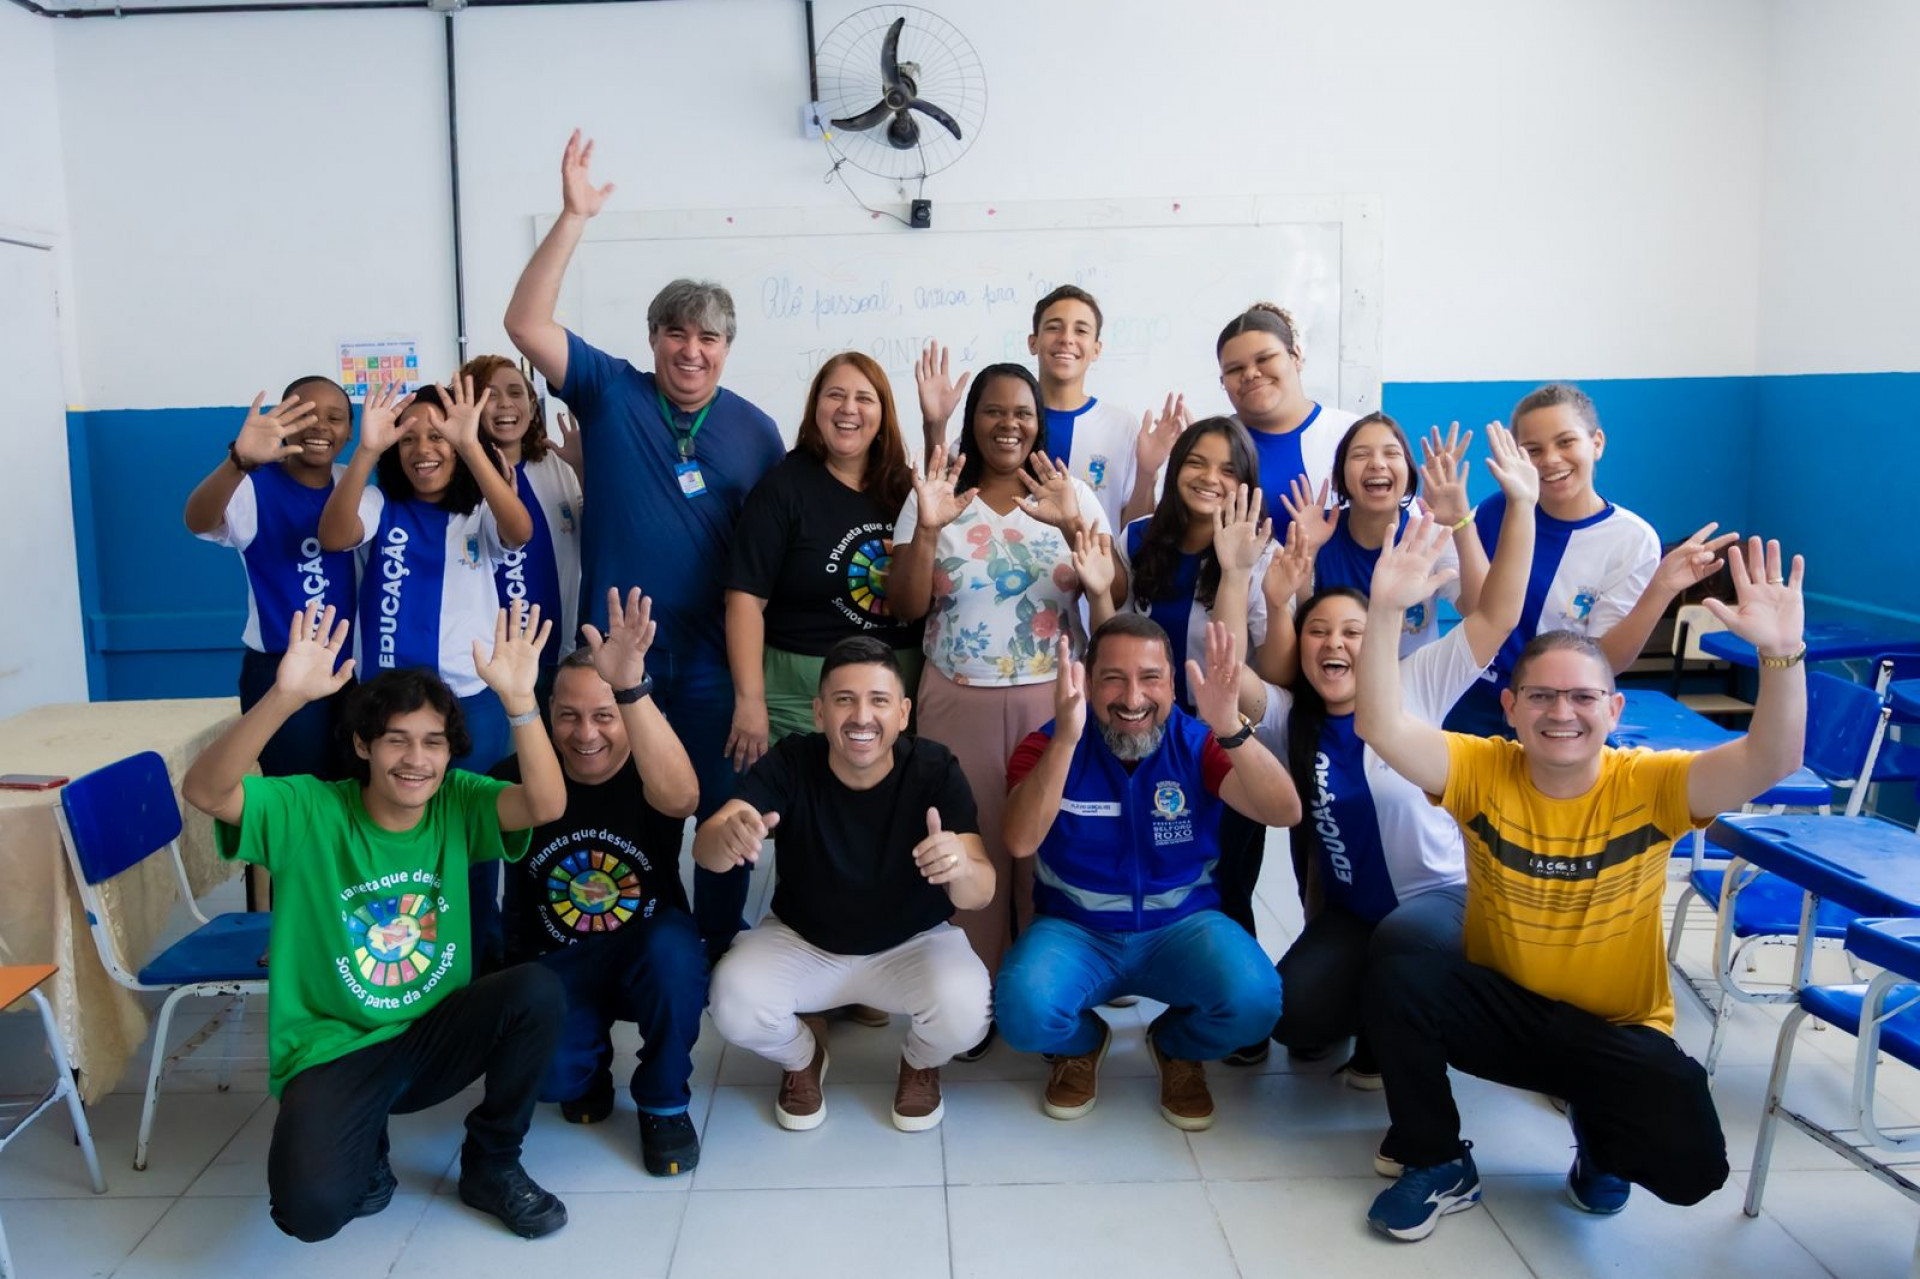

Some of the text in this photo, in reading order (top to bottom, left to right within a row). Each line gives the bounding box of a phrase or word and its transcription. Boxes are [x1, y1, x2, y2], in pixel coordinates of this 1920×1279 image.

[863, 522, 883, 533] que
[830, 527, 862, 561] Planeta
[826, 563, 838, 573] O
[379, 527, 411, 668] EDUCAÇÃO
[530, 828, 653, 872] Planeta que desejamos
[1153, 829, 1193, 841] ROXO
[340, 880, 380, 901] laneta
[380, 871, 408, 888] que
[336, 942, 457, 1009] Somos parte da solução
